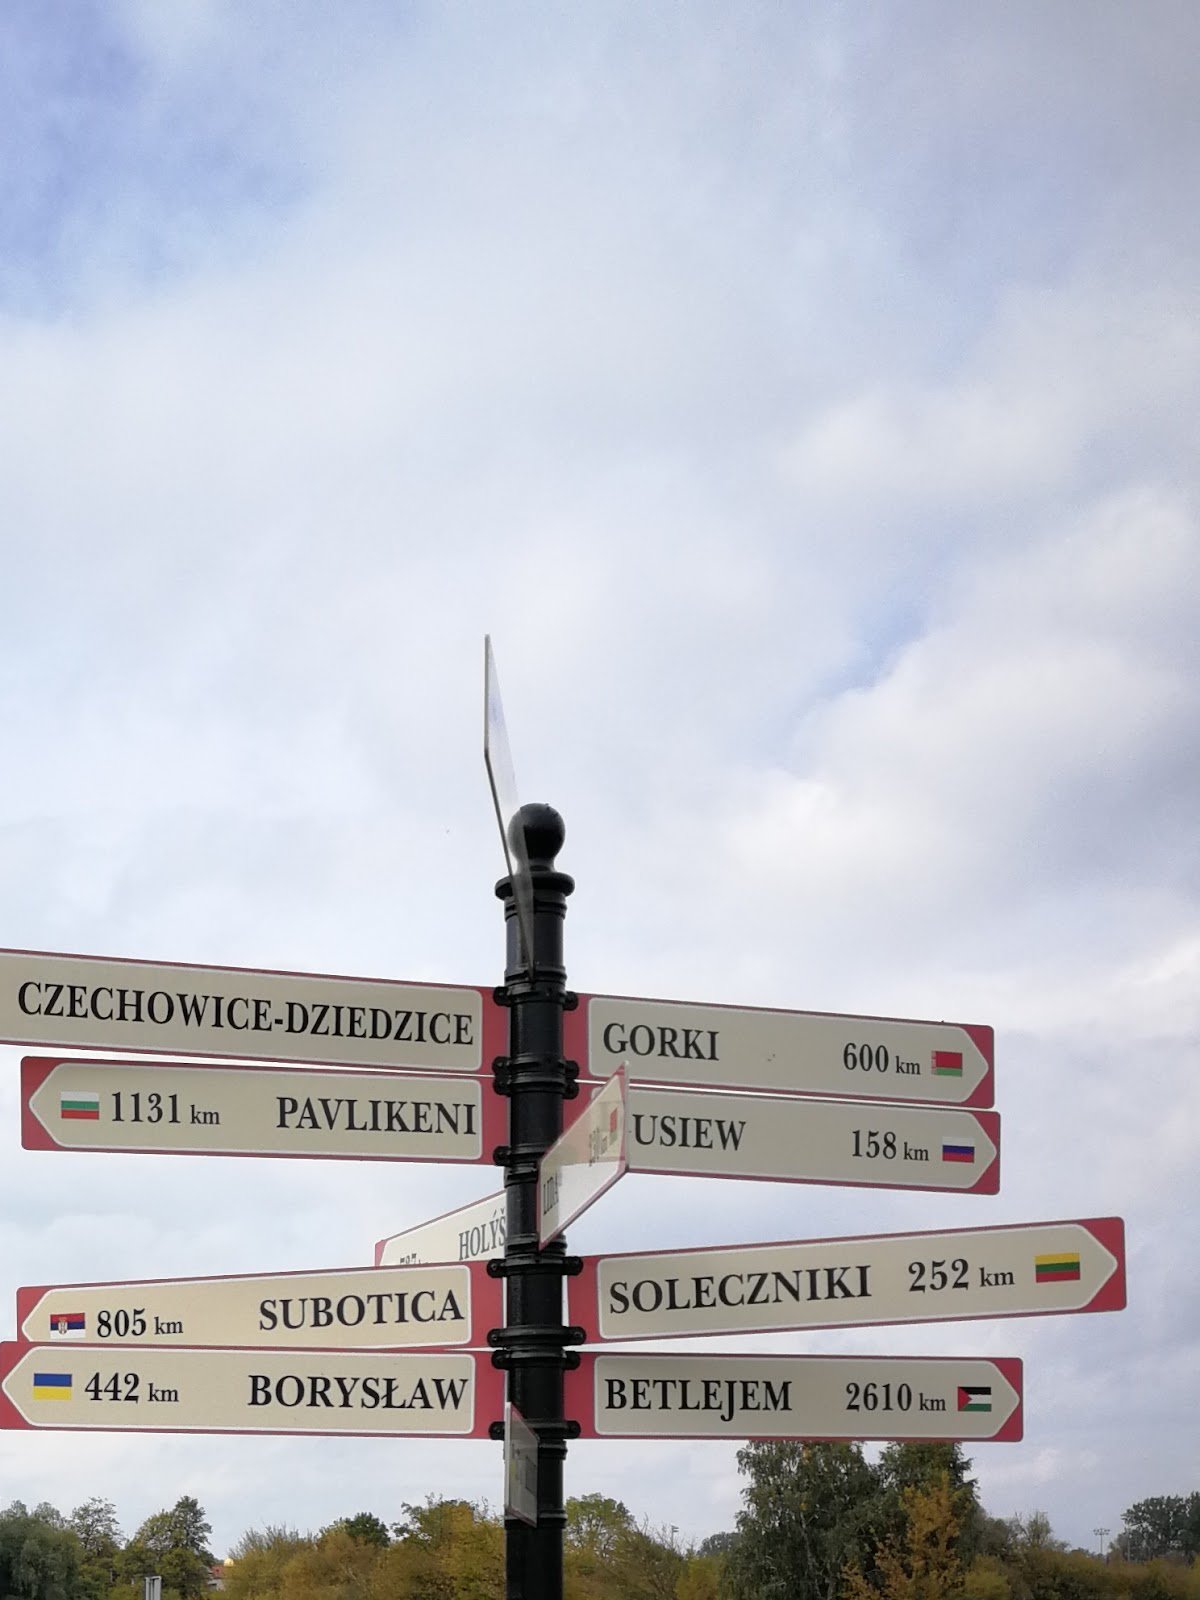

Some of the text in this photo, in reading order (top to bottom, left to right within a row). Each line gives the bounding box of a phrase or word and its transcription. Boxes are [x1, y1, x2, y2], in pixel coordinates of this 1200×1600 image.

[18, 981, 473, 1045] CZECHOWICE-DZIEDZICE
[603, 1022, 921, 1076] GORKI 600 km
[111, 1091, 477, 1136] 1131 km PAVLIKENI
[631, 1113, 747, 1152] USIEW
[851, 1129, 897, 1160] 158
[903, 1141, 930, 1162] km
[459, 1208, 506, 1260] HOLÝŠ
[609, 1258, 1015, 1314] SOLECZNIKI 252 km
[96, 1289, 465, 1339] 805 km SUBOTICA
[84, 1372, 469, 1410] 442 km BORYSŁAW
[604, 1378, 947, 1423] BETLEJEM 2610 km
